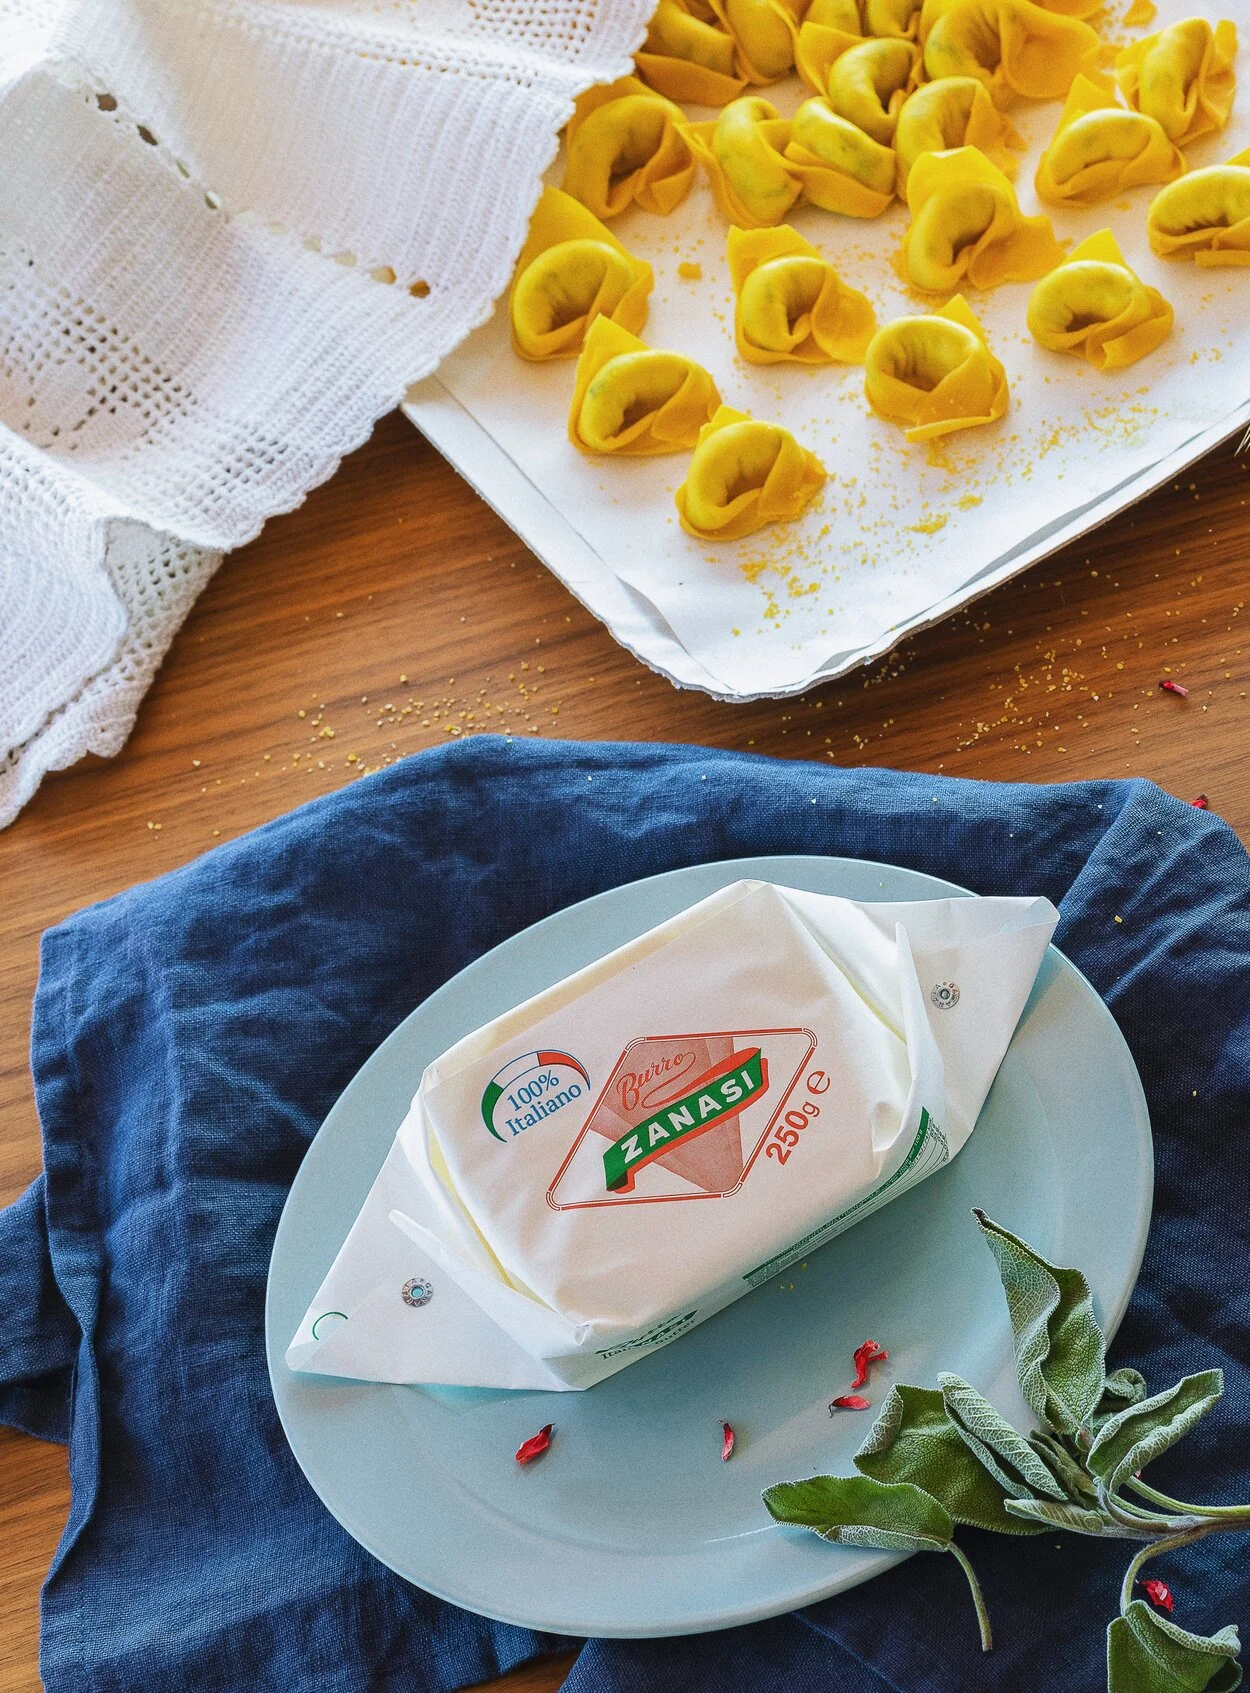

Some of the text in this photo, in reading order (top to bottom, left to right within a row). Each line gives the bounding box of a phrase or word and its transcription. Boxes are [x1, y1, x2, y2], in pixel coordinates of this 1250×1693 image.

[505, 1084, 582, 1136] Italiano
[507, 1069, 560, 1111] 100%
[616, 1051, 697, 1111] Burro
[620, 1070, 755, 1164] ZANASI
[765, 1101, 821, 1166] 250g
